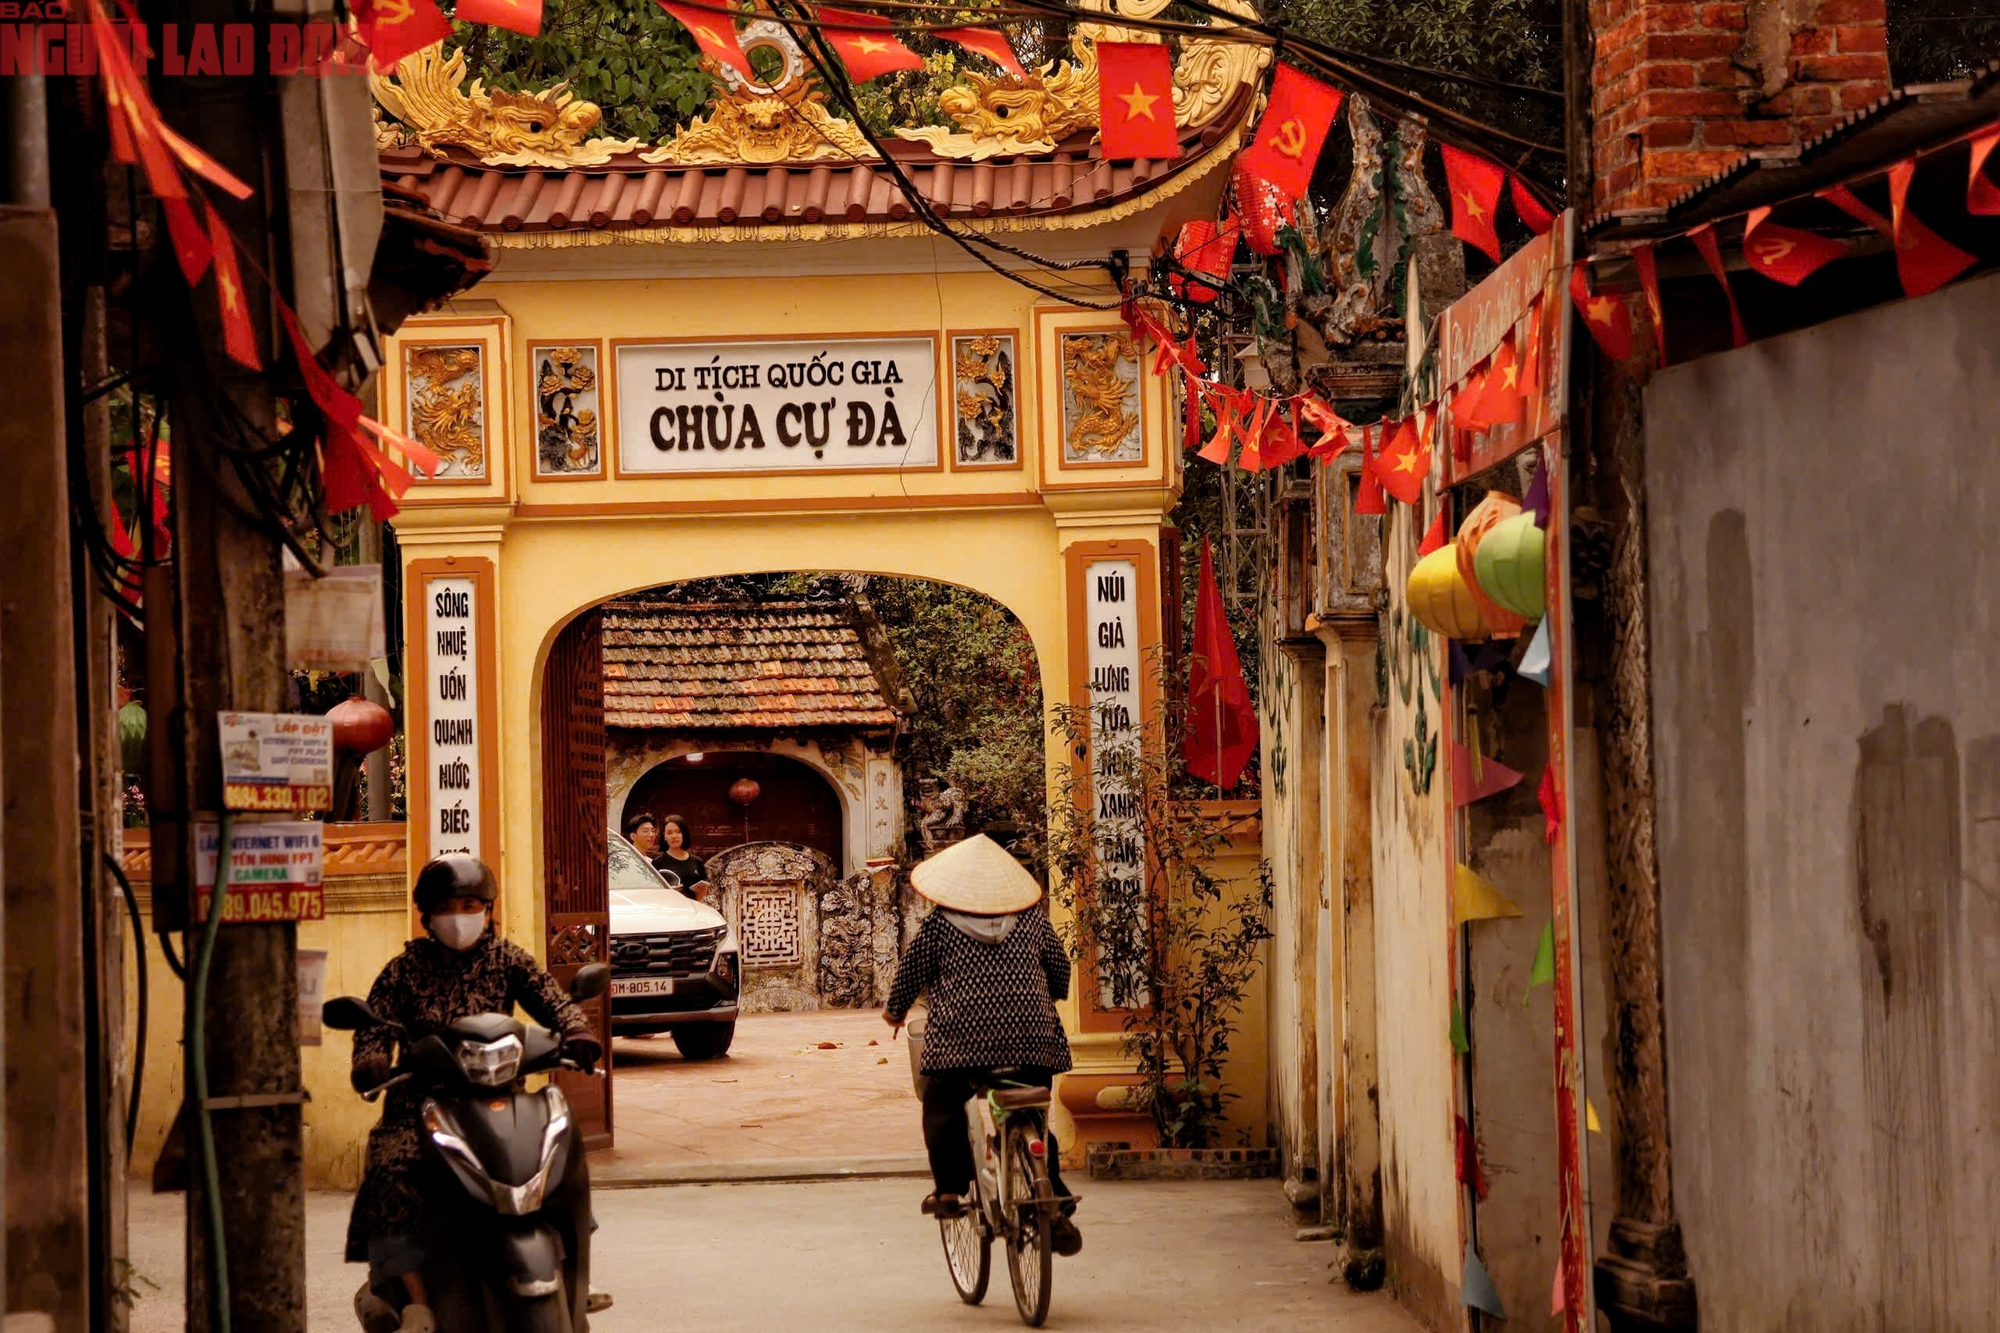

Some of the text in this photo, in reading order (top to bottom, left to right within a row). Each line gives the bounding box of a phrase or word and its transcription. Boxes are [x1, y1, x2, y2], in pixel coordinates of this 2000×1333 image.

[655, 350, 903, 391] DI TÍCH QUỐC GIA
[650, 387, 907, 459] CHÙA CỰ ĐÀ
[1097, 570, 1125, 602] NÚI
[435, 587, 469, 618] SÔNG
[437, 626, 467, 661] NHUỆ
[1098, 616, 1125, 648] GIÀ
[440, 666, 466, 700] UỐN
[1094, 664, 1130, 692] LƯNG
[434, 719, 473, 747] QUANH
[439, 756, 470, 790] NƯỚC
[440, 800, 470, 834] BIẾC
[231, 836, 280, 850] NTERNET
[283, 835, 309, 849] WIFI
[234, 868, 288, 881] CAMERA
[200, 891, 321, 920] 089.045.975
